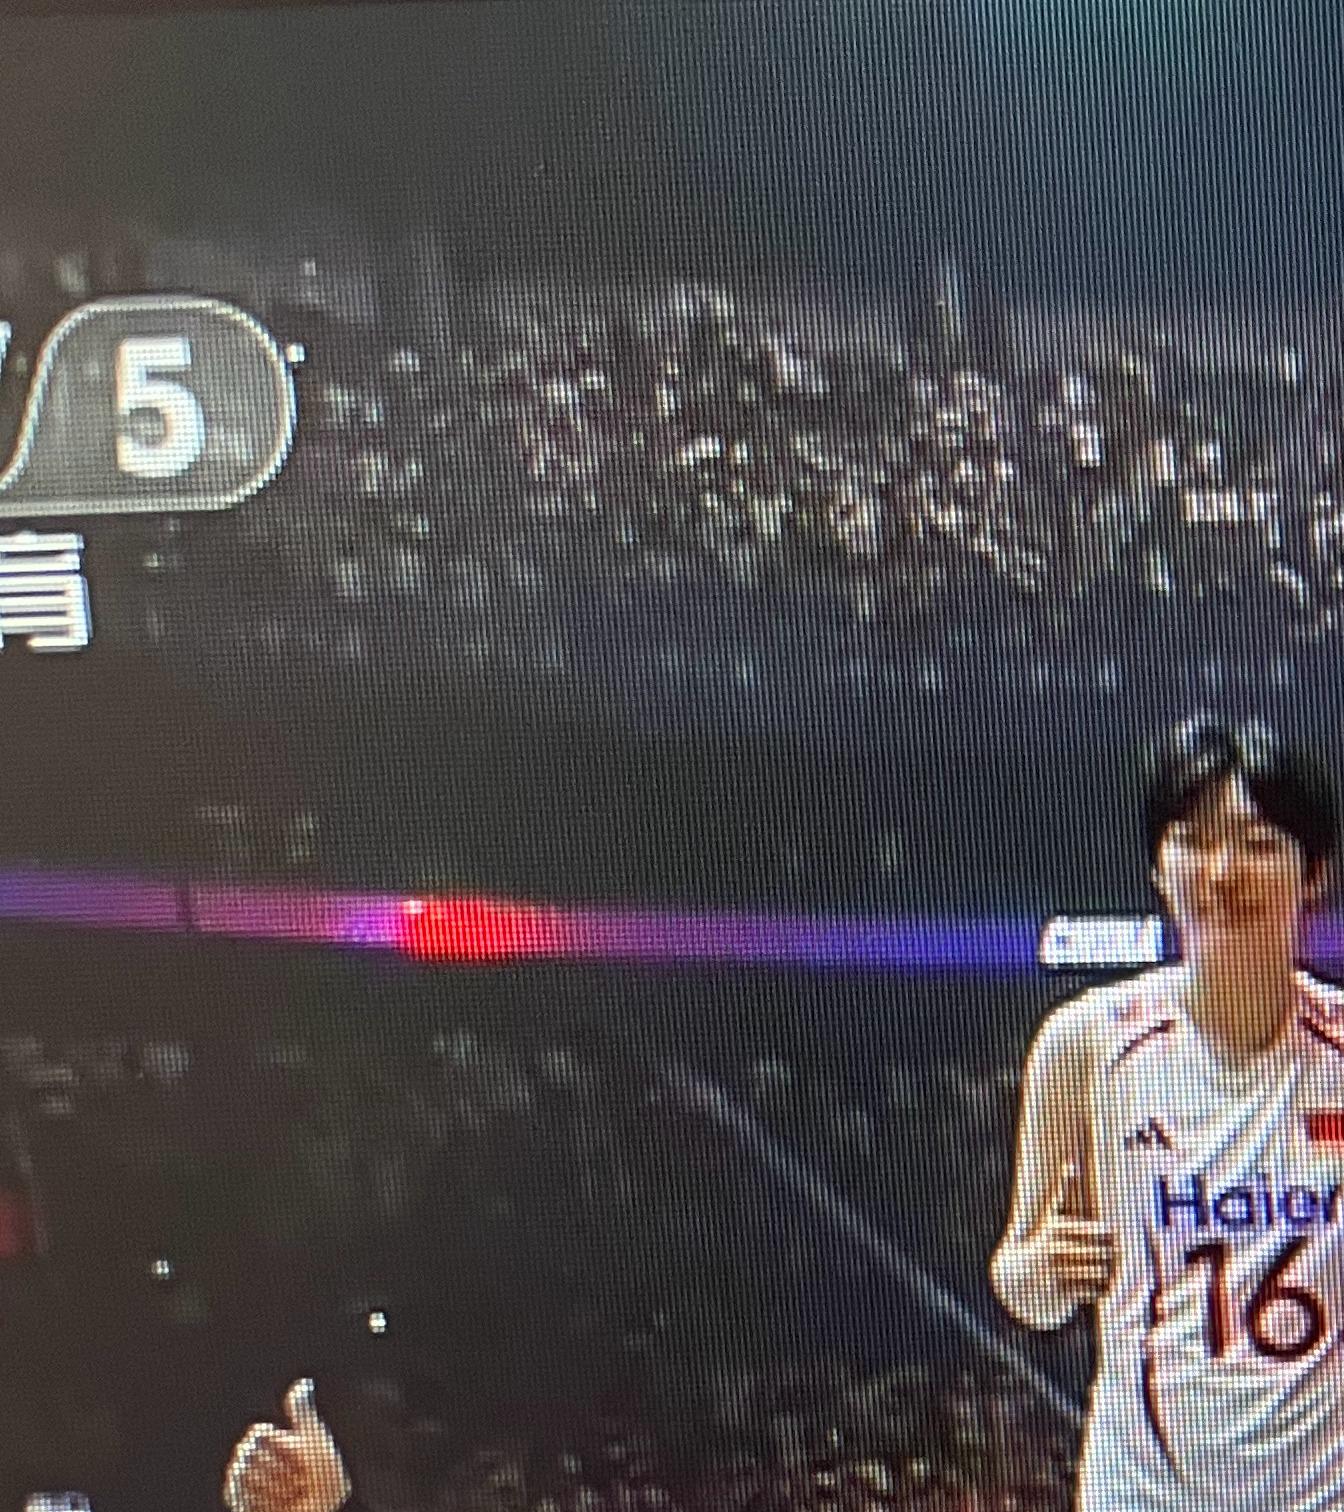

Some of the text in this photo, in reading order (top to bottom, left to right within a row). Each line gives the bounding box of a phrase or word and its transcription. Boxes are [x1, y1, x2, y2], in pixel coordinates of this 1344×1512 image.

[114, 334, 206, 478] 5
[1153, 1172, 1344, 1228] Haier
[1184, 1235, 1327, 1360] 16
